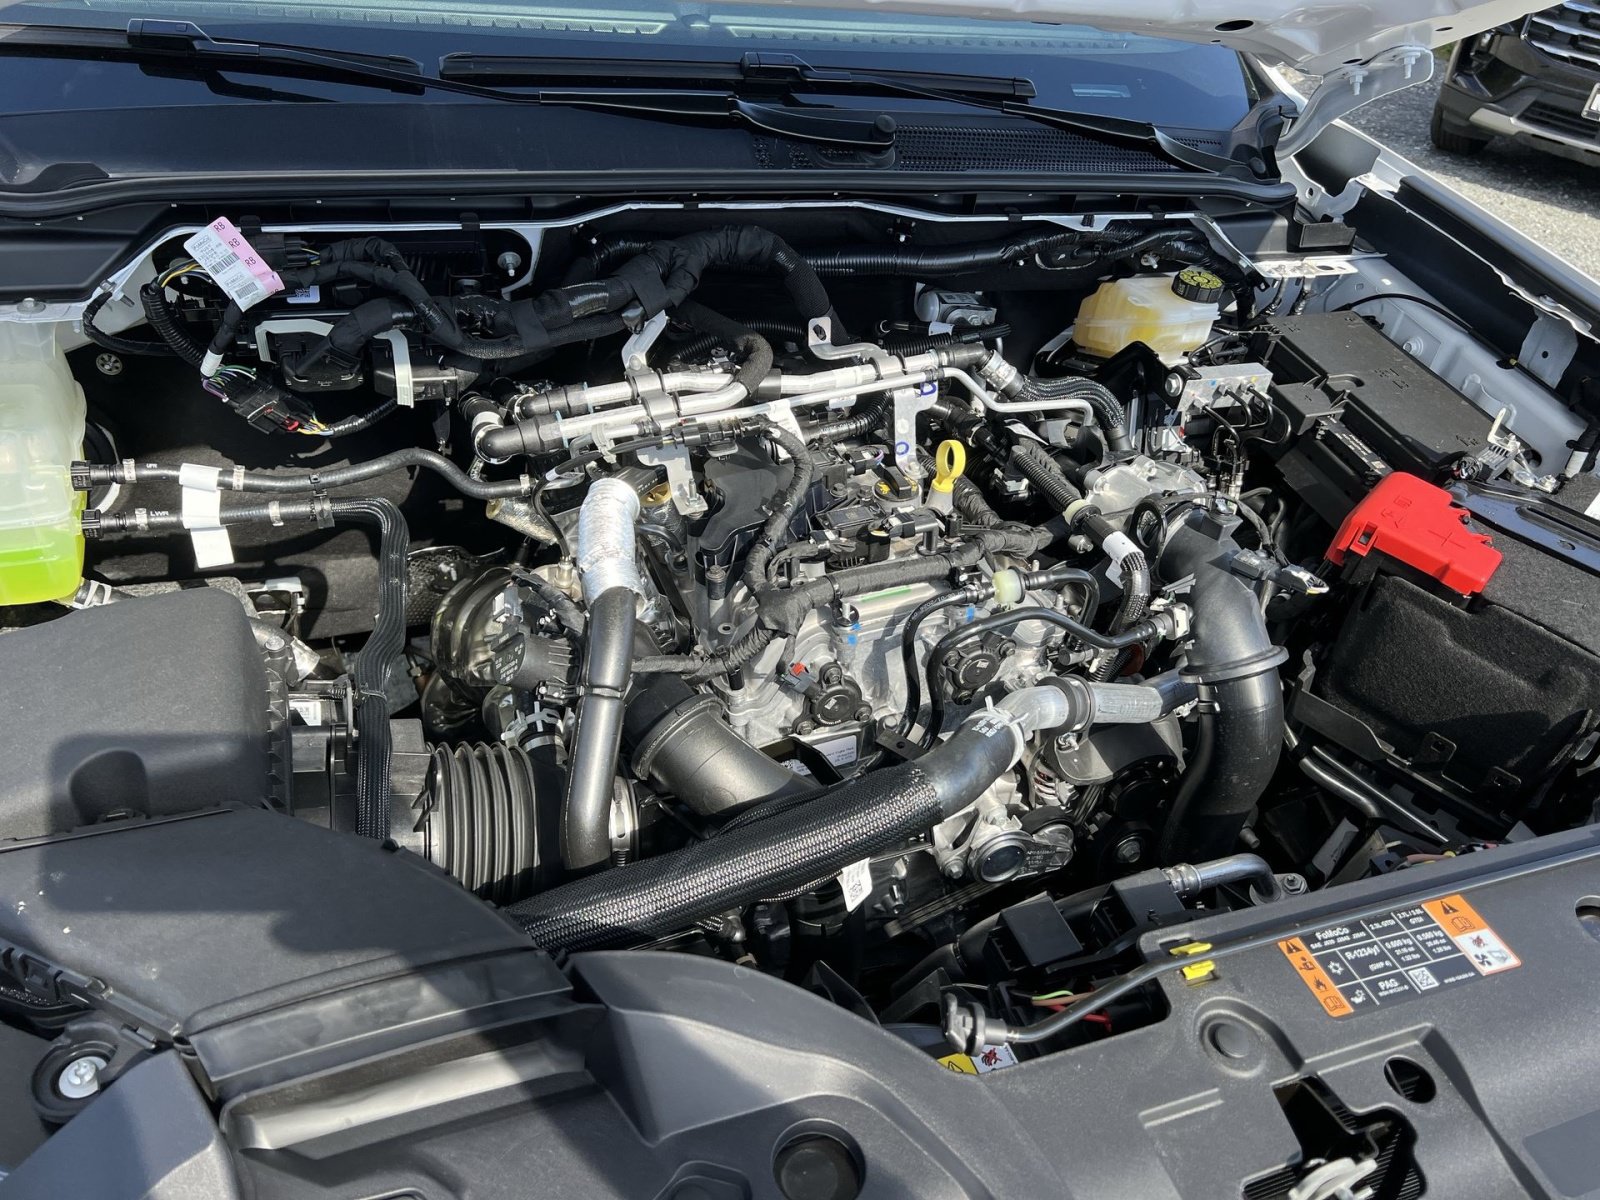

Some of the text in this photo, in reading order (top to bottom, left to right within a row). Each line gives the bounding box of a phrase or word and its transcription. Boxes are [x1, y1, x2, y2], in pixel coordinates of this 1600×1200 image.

[213, 221, 226, 232] RB
[228, 237, 240, 249] RB
[244, 256, 257, 267] RB
[1315, 927, 1350, 941] FoMoCo
[1344, 944, 1381, 961] R-1234yf
[1378, 978, 1400, 991] PAG
